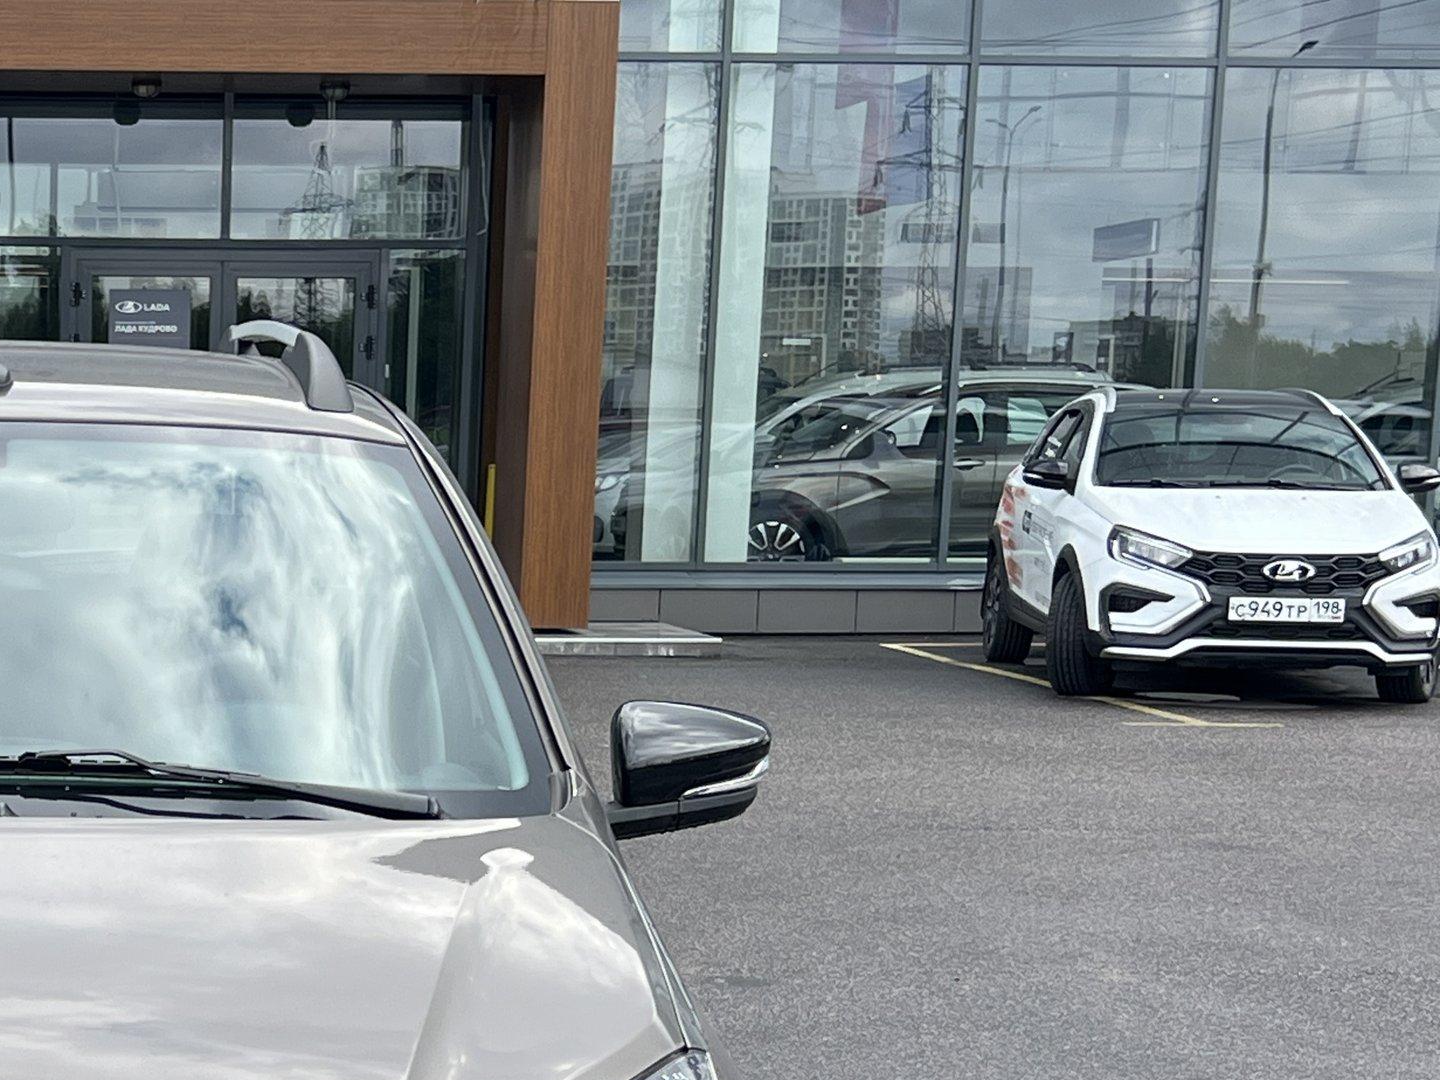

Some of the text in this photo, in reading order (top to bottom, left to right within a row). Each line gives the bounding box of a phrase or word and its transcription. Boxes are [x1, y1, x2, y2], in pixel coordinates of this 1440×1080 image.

[143, 303, 170, 311] LADA
[114, 325, 137, 333] ЛАДА
[1313, 601, 1339, 615] 198
